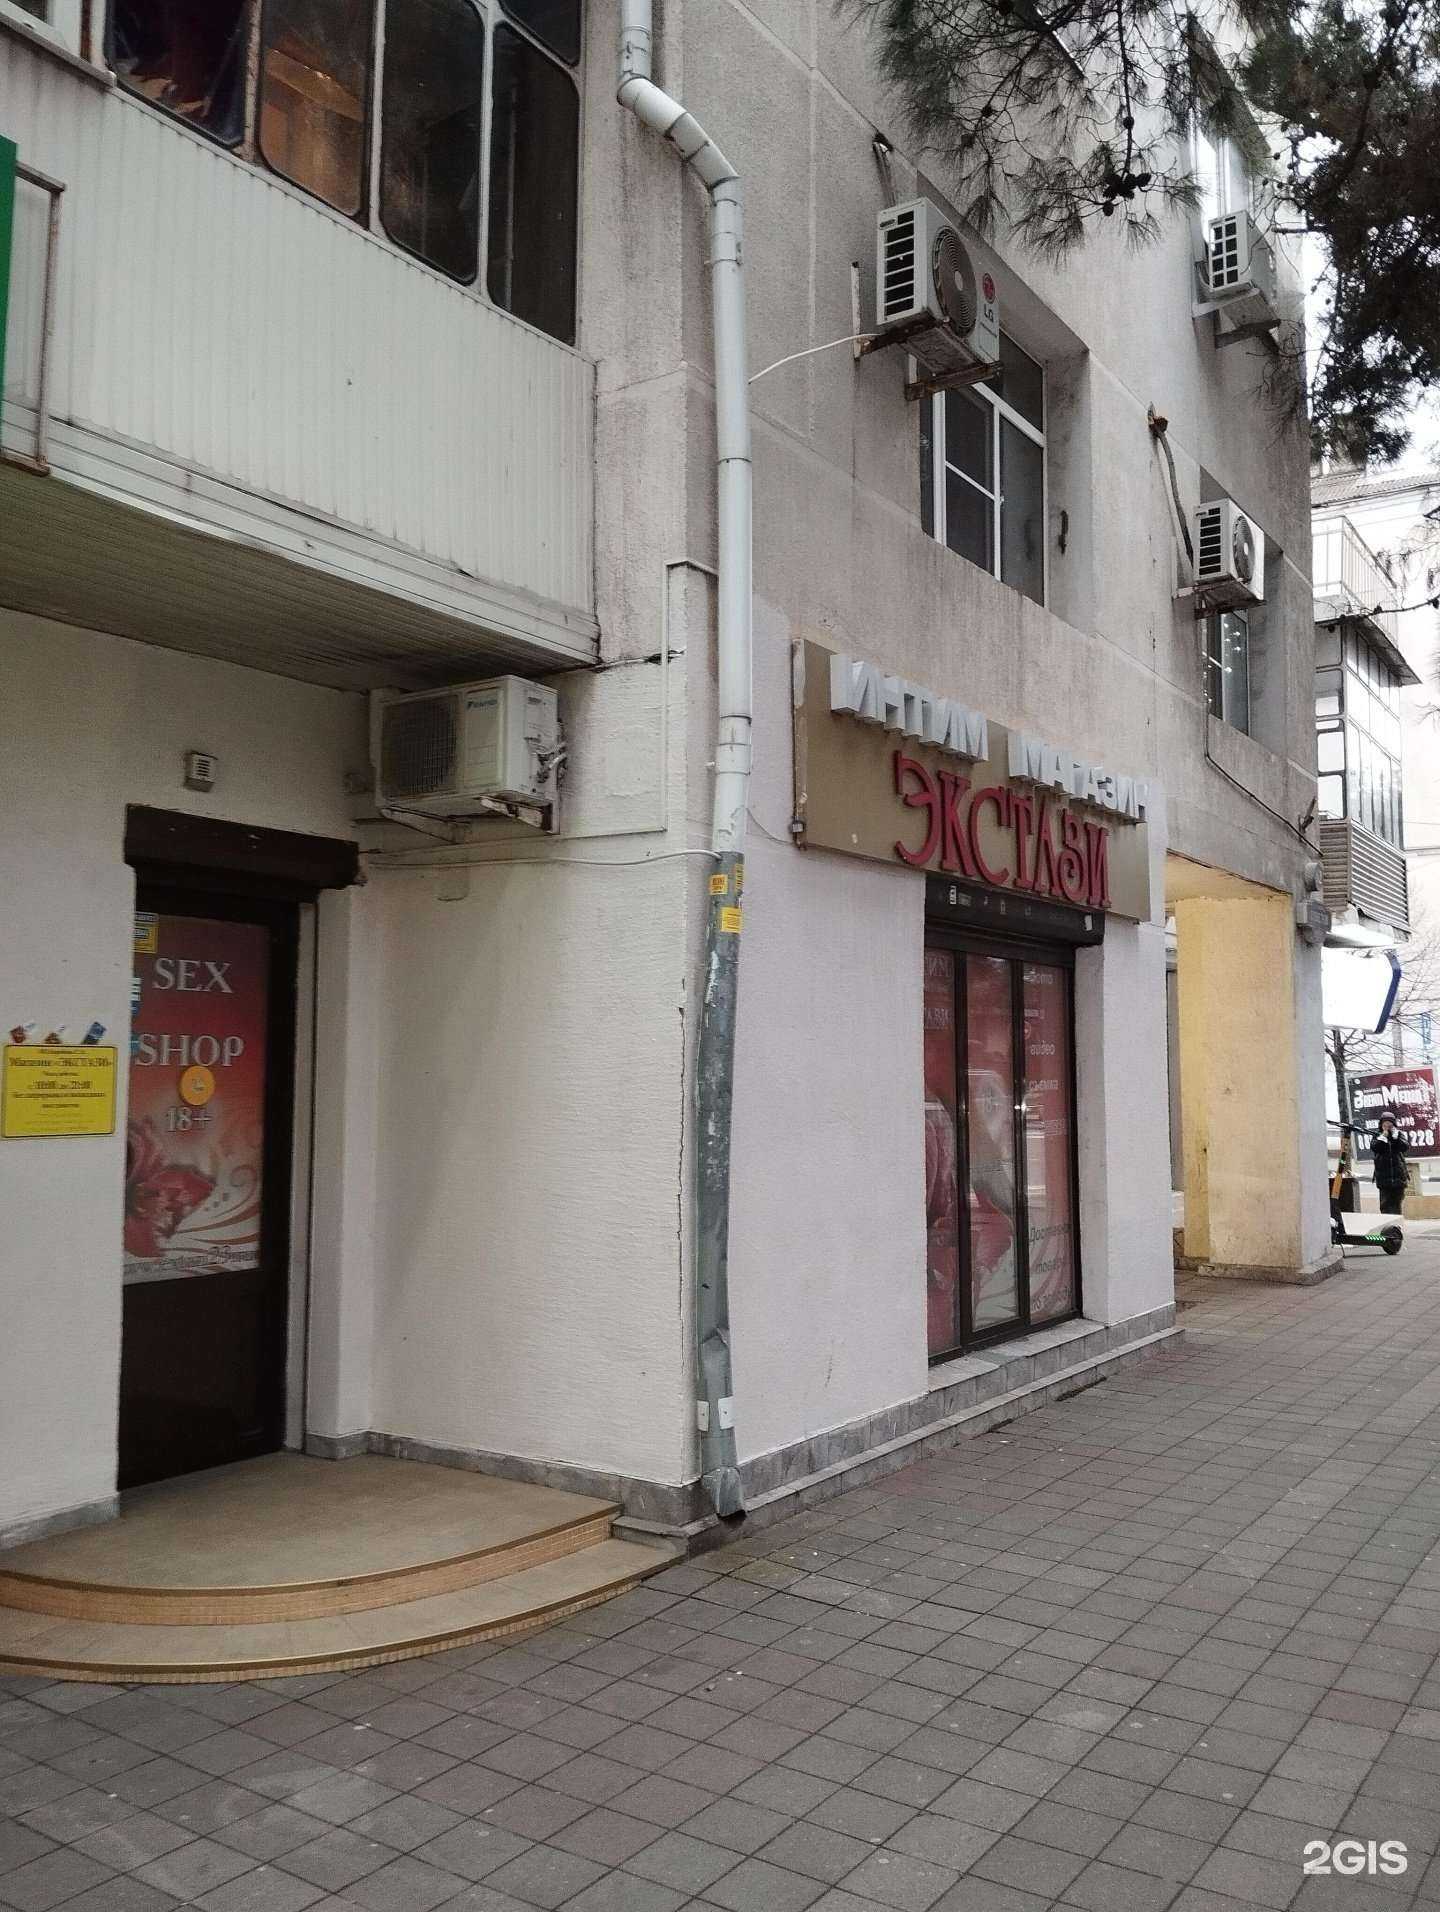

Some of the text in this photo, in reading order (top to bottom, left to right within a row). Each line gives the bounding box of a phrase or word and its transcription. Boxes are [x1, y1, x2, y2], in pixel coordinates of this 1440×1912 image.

[830, 654, 1148, 824] ИНТИМ МАГАЗИН
[892, 750, 1112, 908] ЭКСТАЗИ
[152, 957, 233, 994] SEX
[135, 1033, 244, 1068] SHOP
[166, 1106, 213, 1132] 18+
